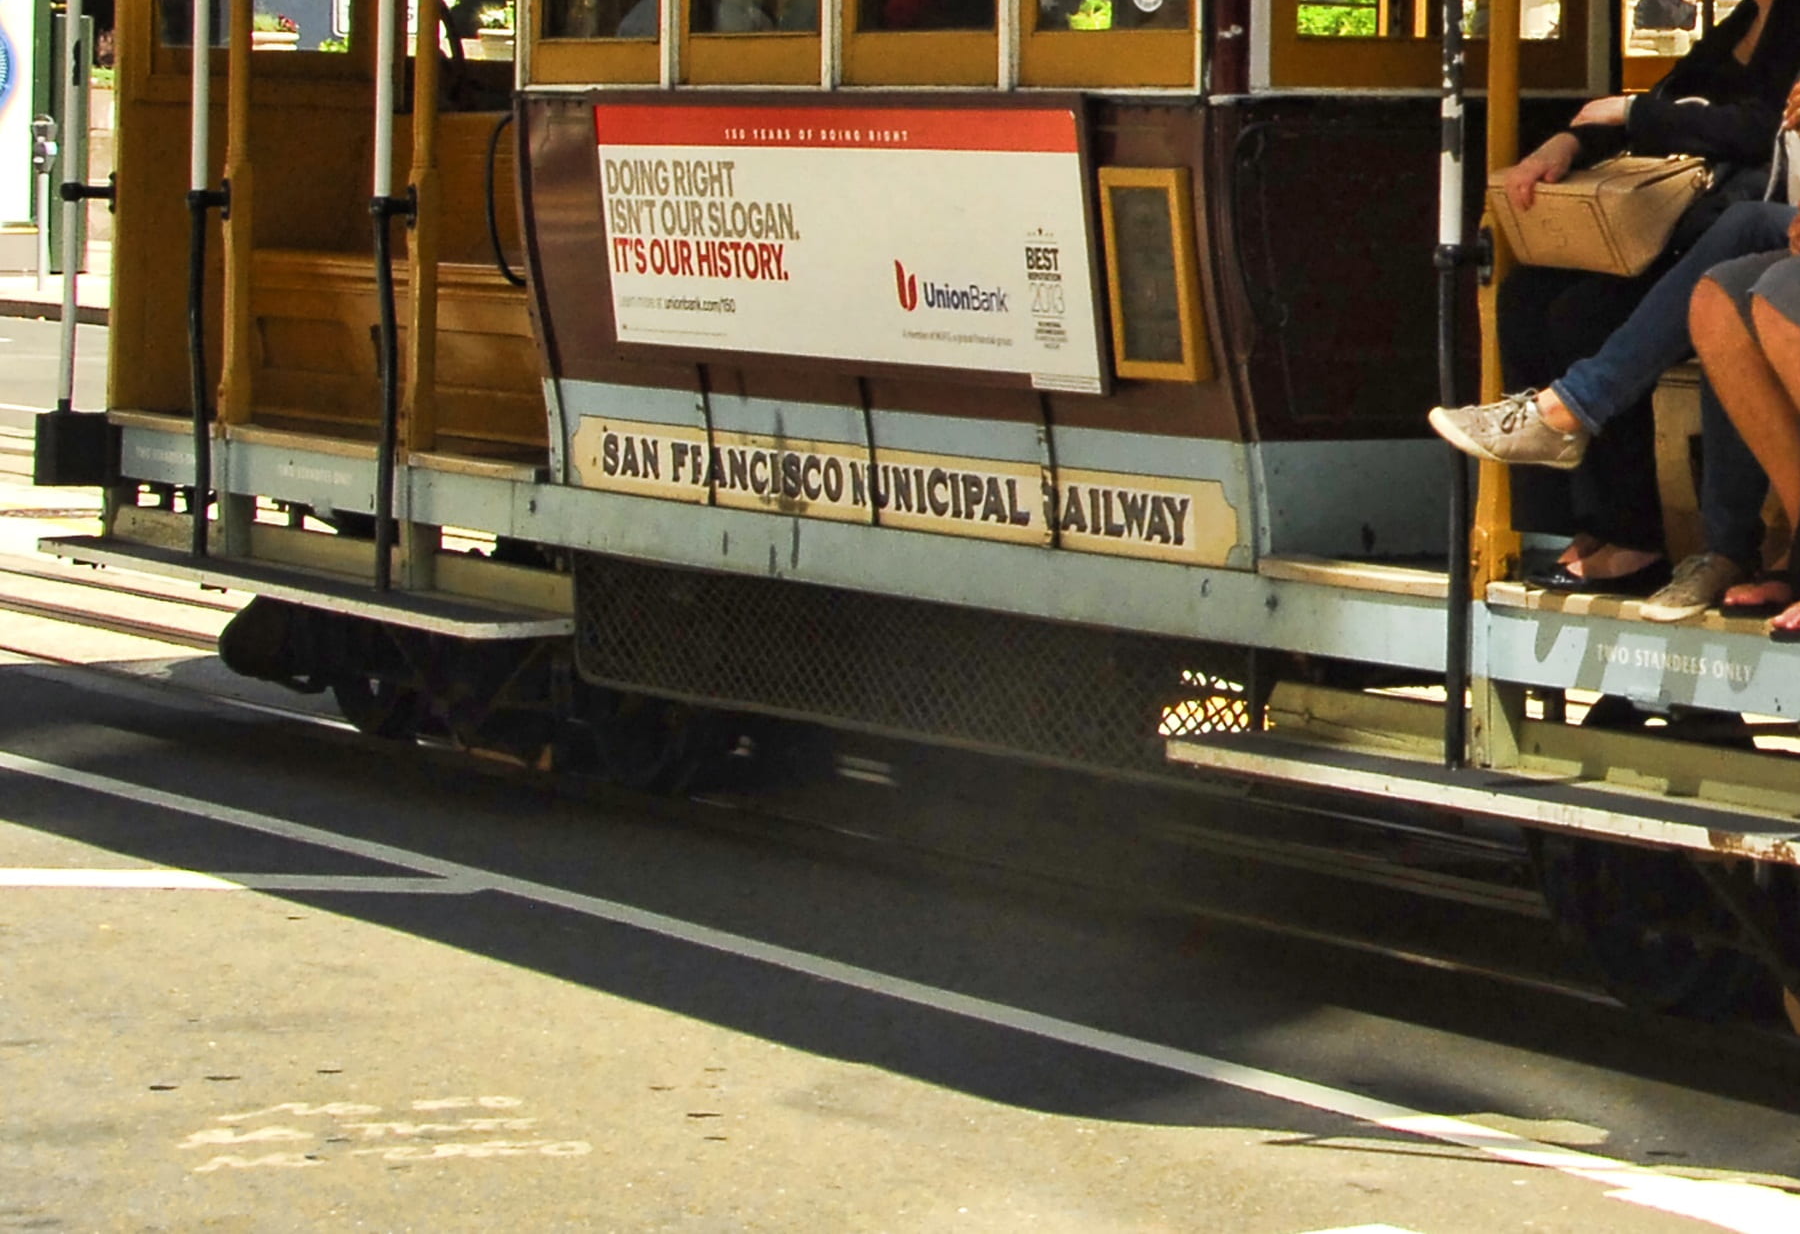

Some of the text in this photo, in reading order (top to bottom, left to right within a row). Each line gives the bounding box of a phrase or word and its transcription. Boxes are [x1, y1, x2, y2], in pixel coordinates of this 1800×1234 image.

[753, 128, 791, 141] YEARS
[798, 129, 813, 140] OF
[820, 129, 861, 142] DOING
[868, 130, 908, 142] RIGHT
[605, 159, 735, 198] DOING RIGHT
[609, 199, 800, 241] ISN'T OUR SLOGAN.
[613, 237, 789, 281] IT'S OUR HISTORY.
[1025, 247, 1059, 271] BEST
[923, 281, 1009, 313] UnionBank
[1029, 282, 1066, 314] 2013
[603, 433, 660, 480] SAN
[1597, 644, 1750, 681] TWO STANDEES ONLY
